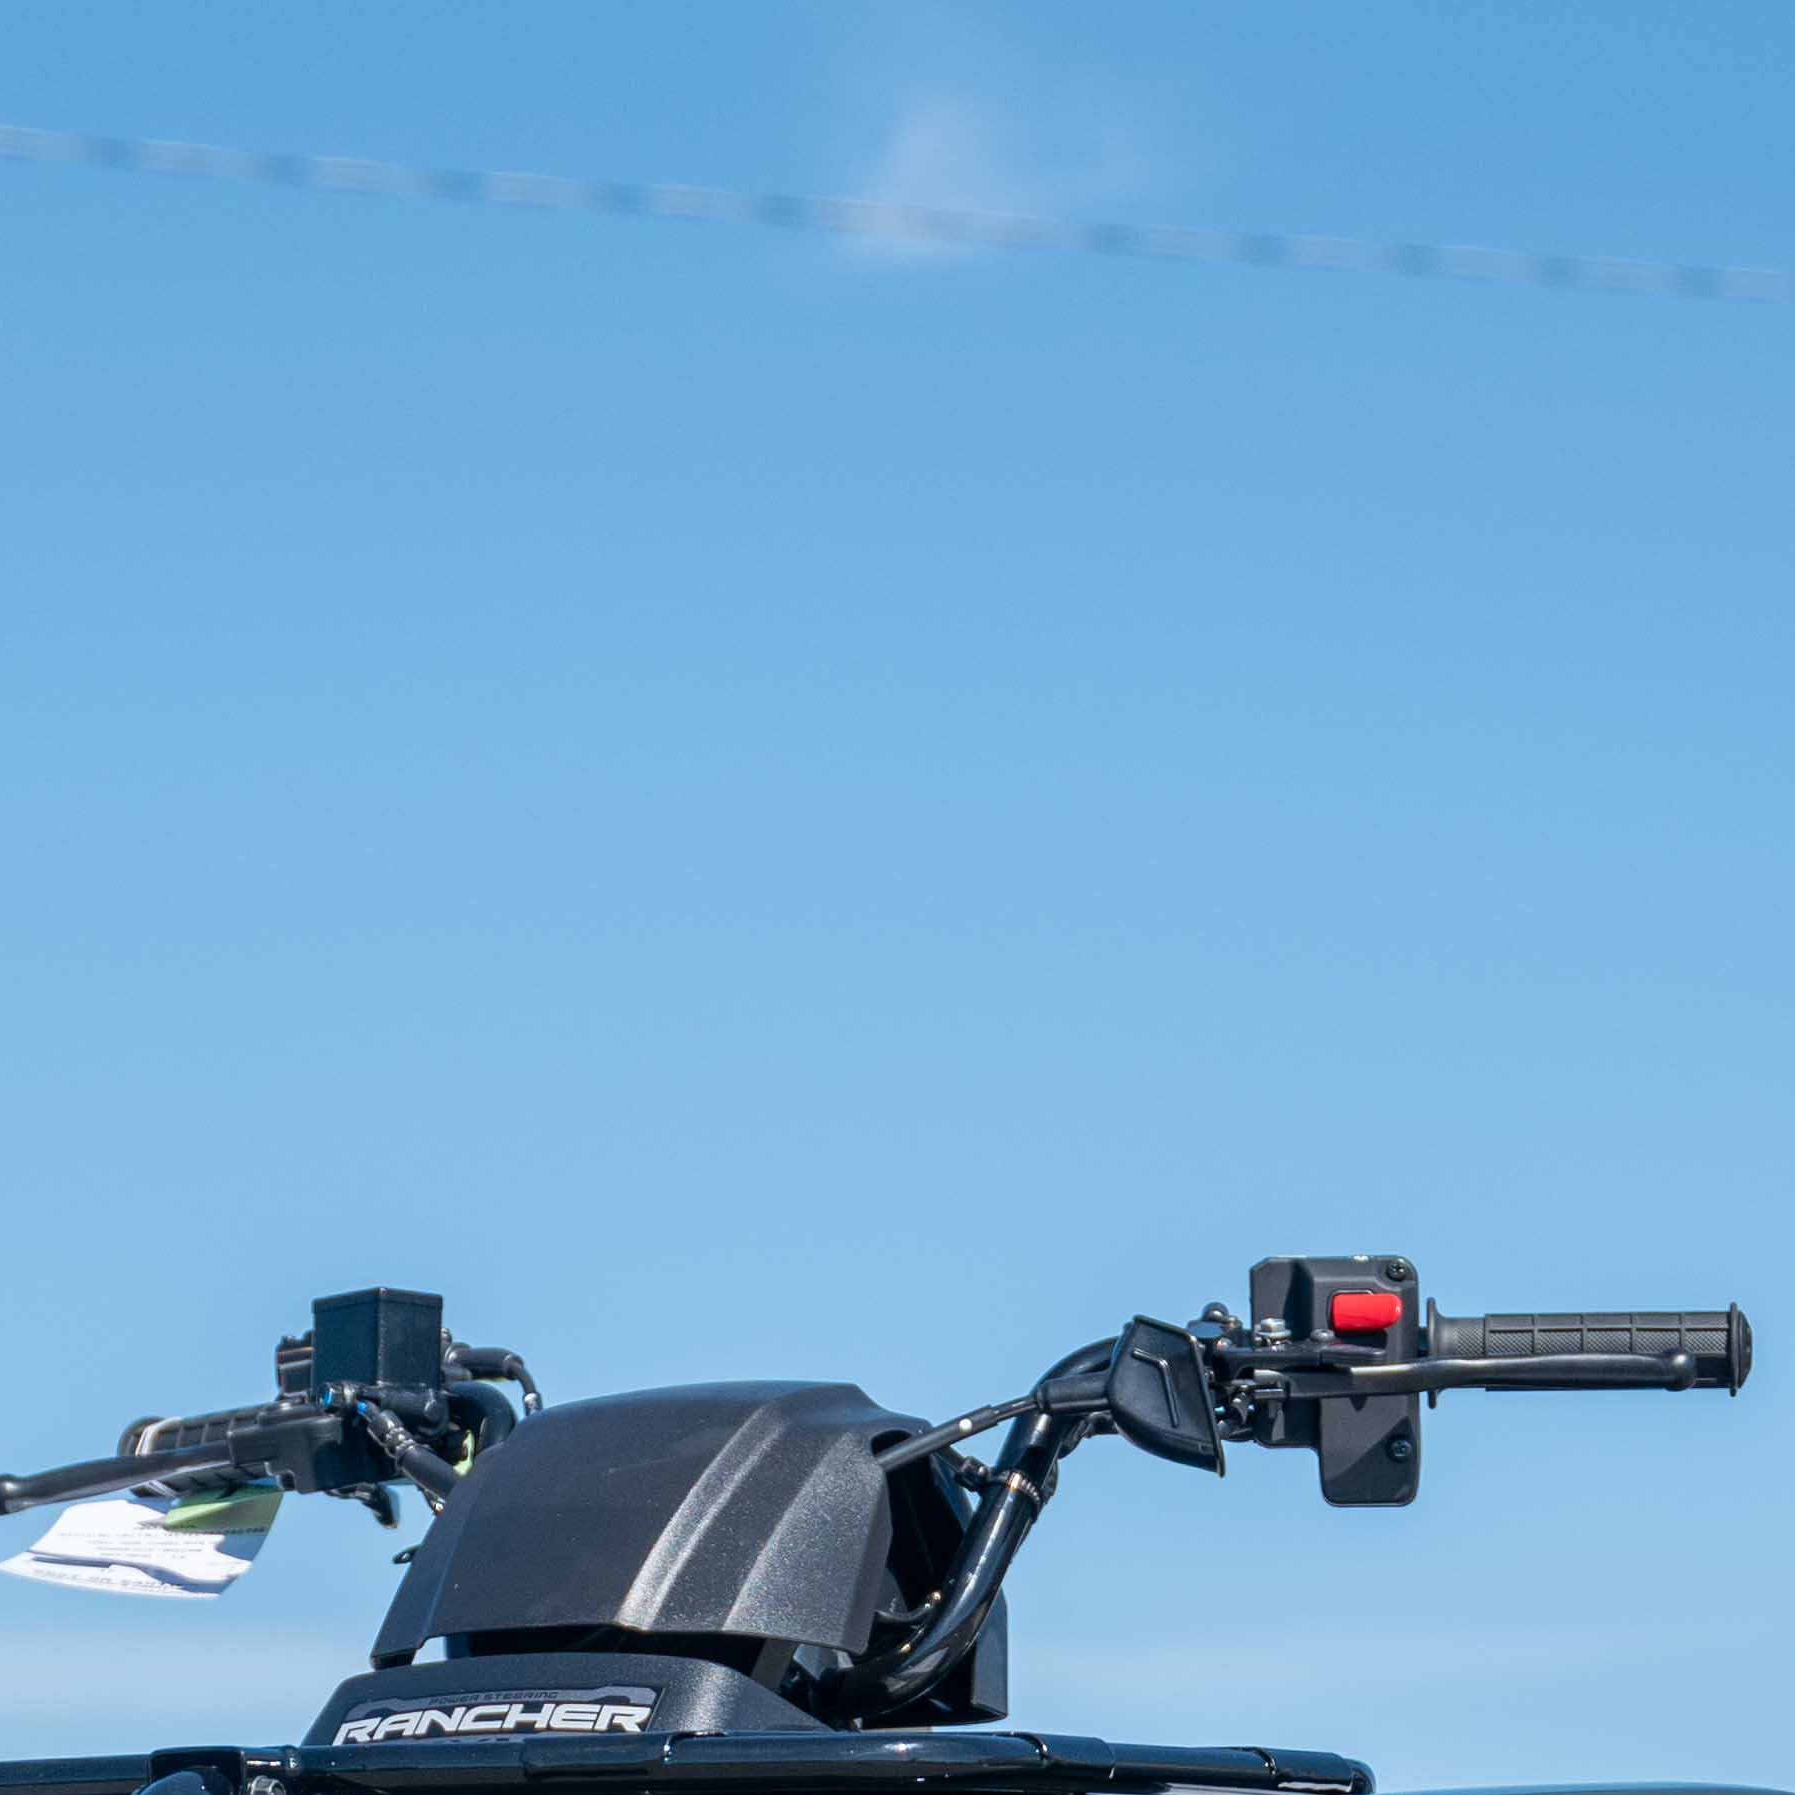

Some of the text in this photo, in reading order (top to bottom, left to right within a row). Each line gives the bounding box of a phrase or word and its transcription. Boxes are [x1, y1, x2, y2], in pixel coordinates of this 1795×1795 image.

[428, 1690, 558, 1706] POWER STEERING
[331, 1702, 652, 1746] RANCHER
